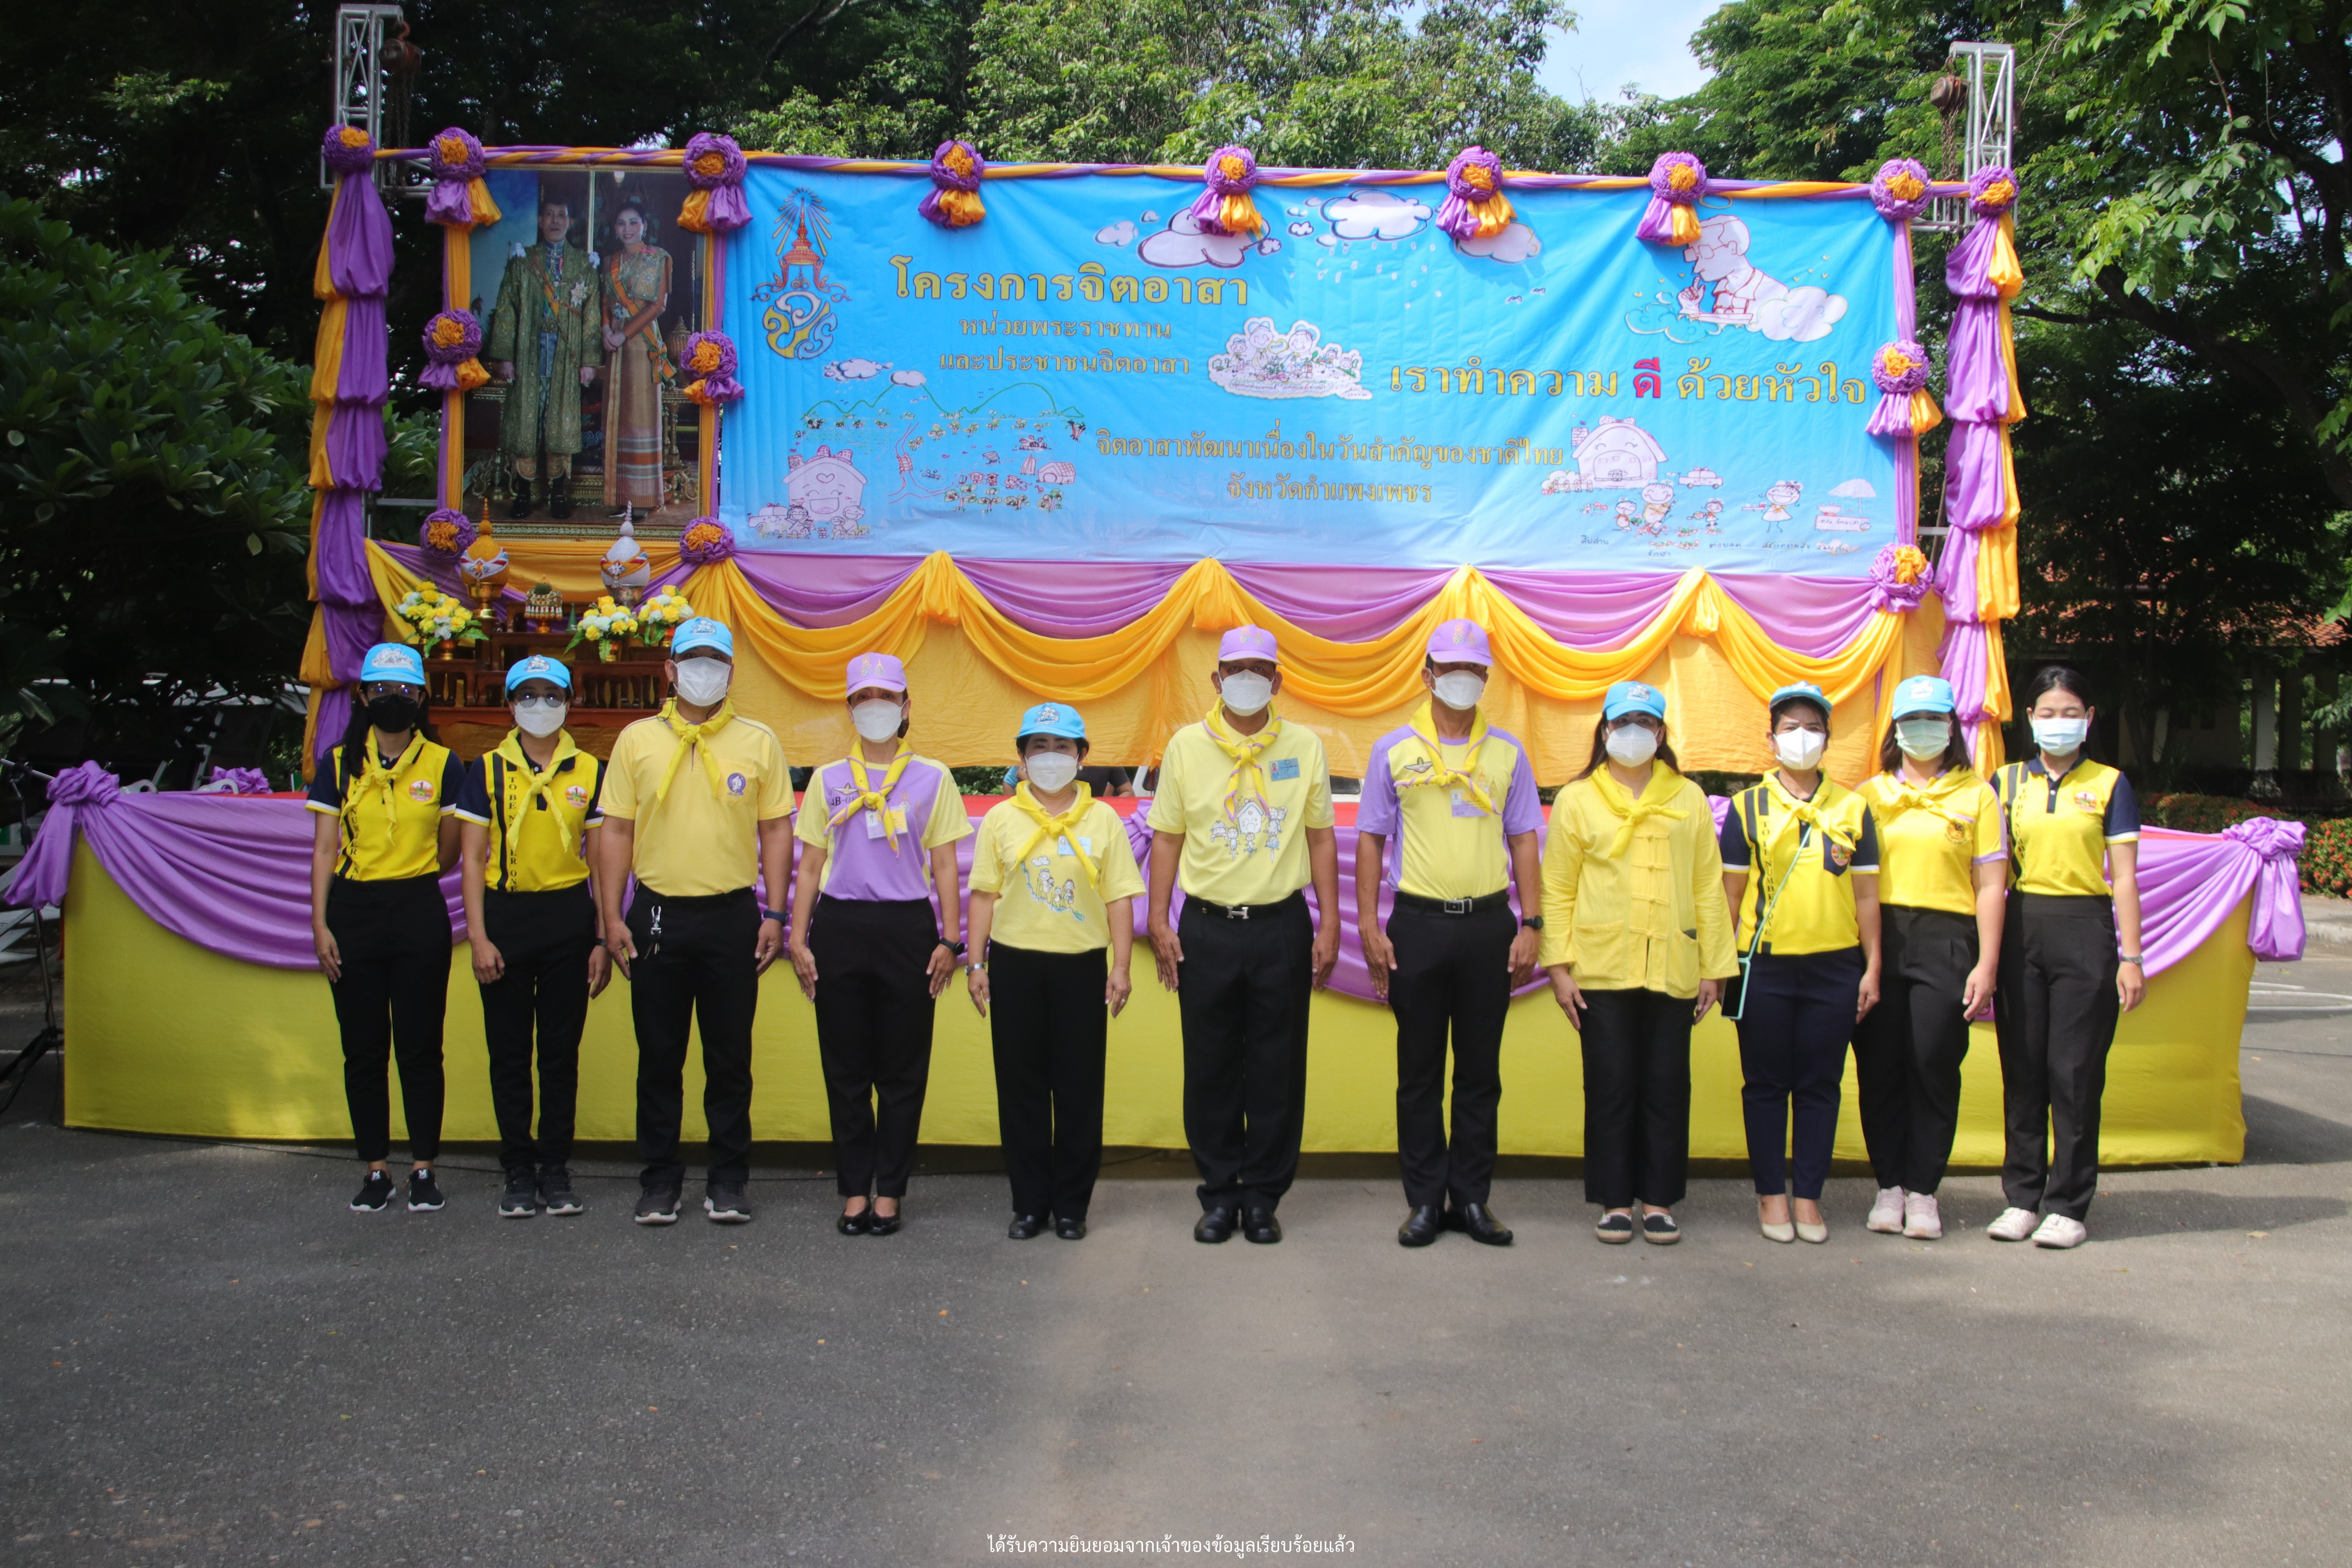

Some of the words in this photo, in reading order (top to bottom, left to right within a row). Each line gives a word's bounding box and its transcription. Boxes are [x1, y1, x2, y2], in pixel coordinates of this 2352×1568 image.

[888, 254, 1248, 306] โครงการจิตอาสา
[959, 311, 1171, 338] หน่วยพระราชทาน
[940, 347, 1189, 374] และประชาชนจิตอาสา
[1390, 356, 1617, 397] เราทำความ
[1633, 358, 1661, 398] ดี
[1677, 358, 1866, 404] ด้วยหัวใจ
[1096, 419, 1564, 470] จิตอาสาพัฒนาเนื่องในวันสำคัญของชาติไทย
[1226, 472, 1432, 503] จังหวัดกำแพงเพชร
[508, 777, 517, 789] TO
[509, 794, 517, 809] BE
[1762, 821, 1770, 836] TO
